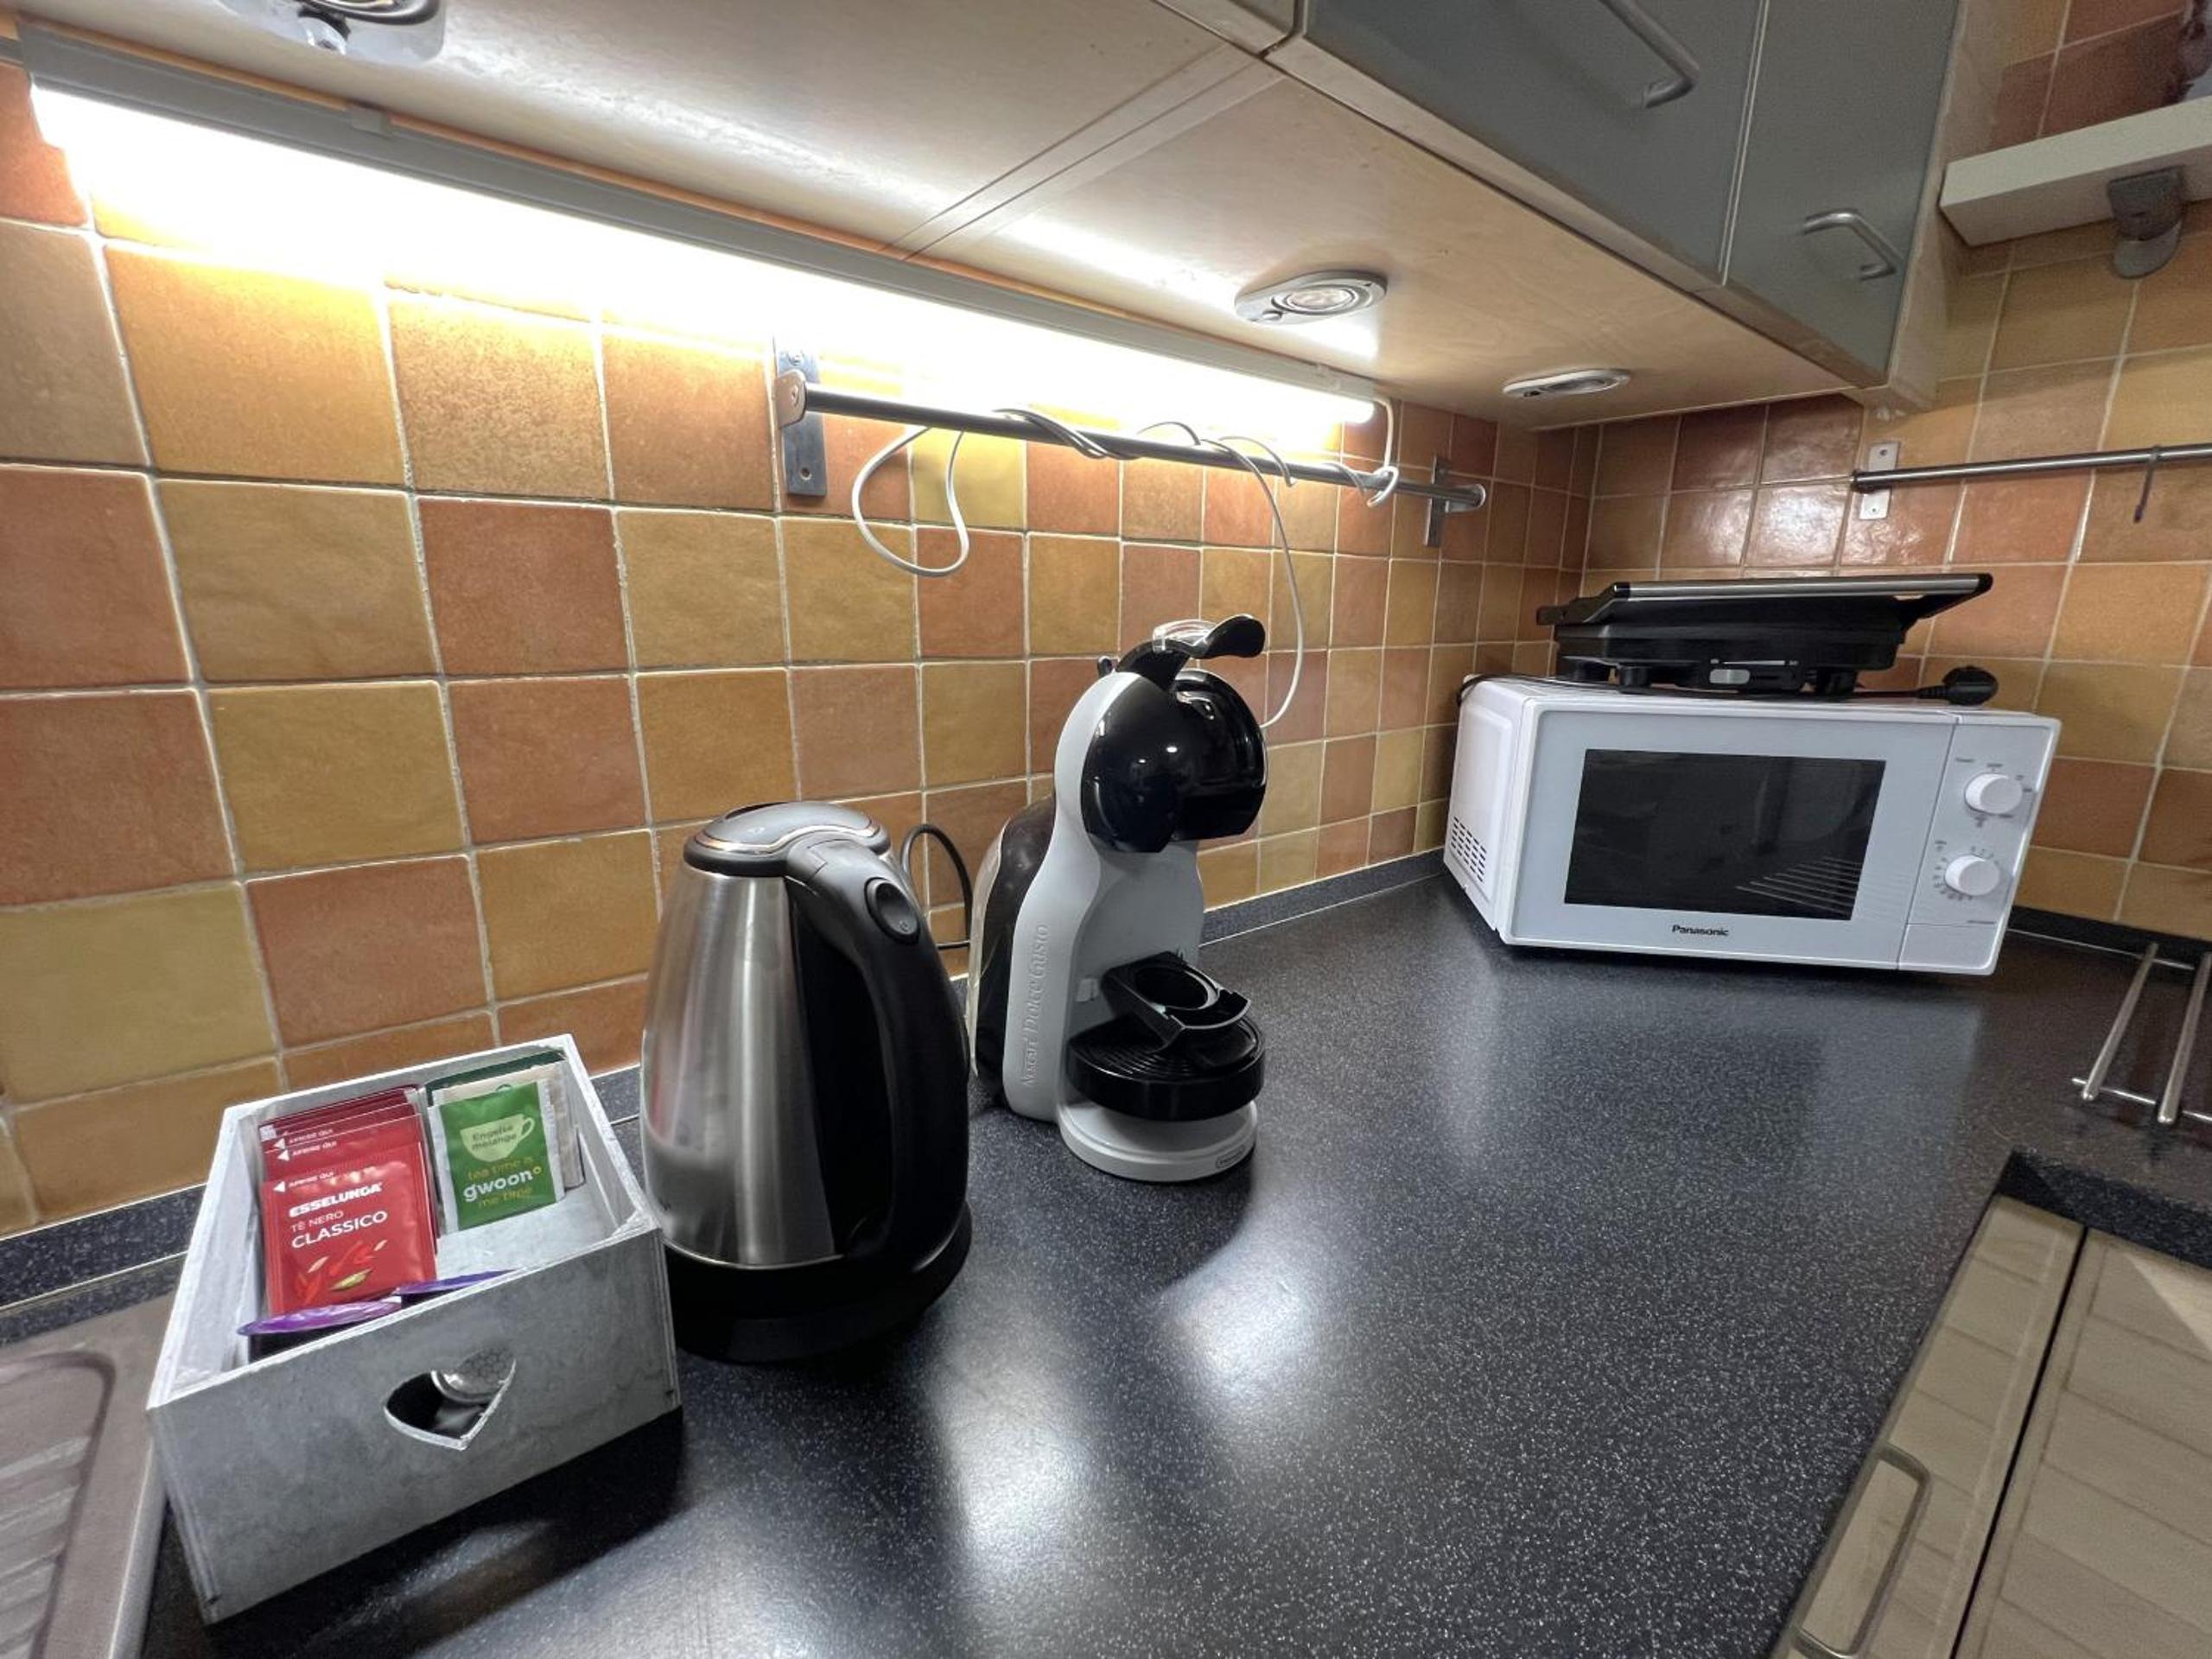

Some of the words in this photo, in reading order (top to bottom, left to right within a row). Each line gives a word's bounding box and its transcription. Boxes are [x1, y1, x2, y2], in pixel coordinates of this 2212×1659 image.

[1671, 924, 1729, 937] Panasonic
[289, 1183, 382, 1217] ESSELUNGA
[463, 1170, 533, 1202] gwoon
[292, 1211, 388, 1248] CLASSICO
[308, 1211, 344, 1227] NERO
